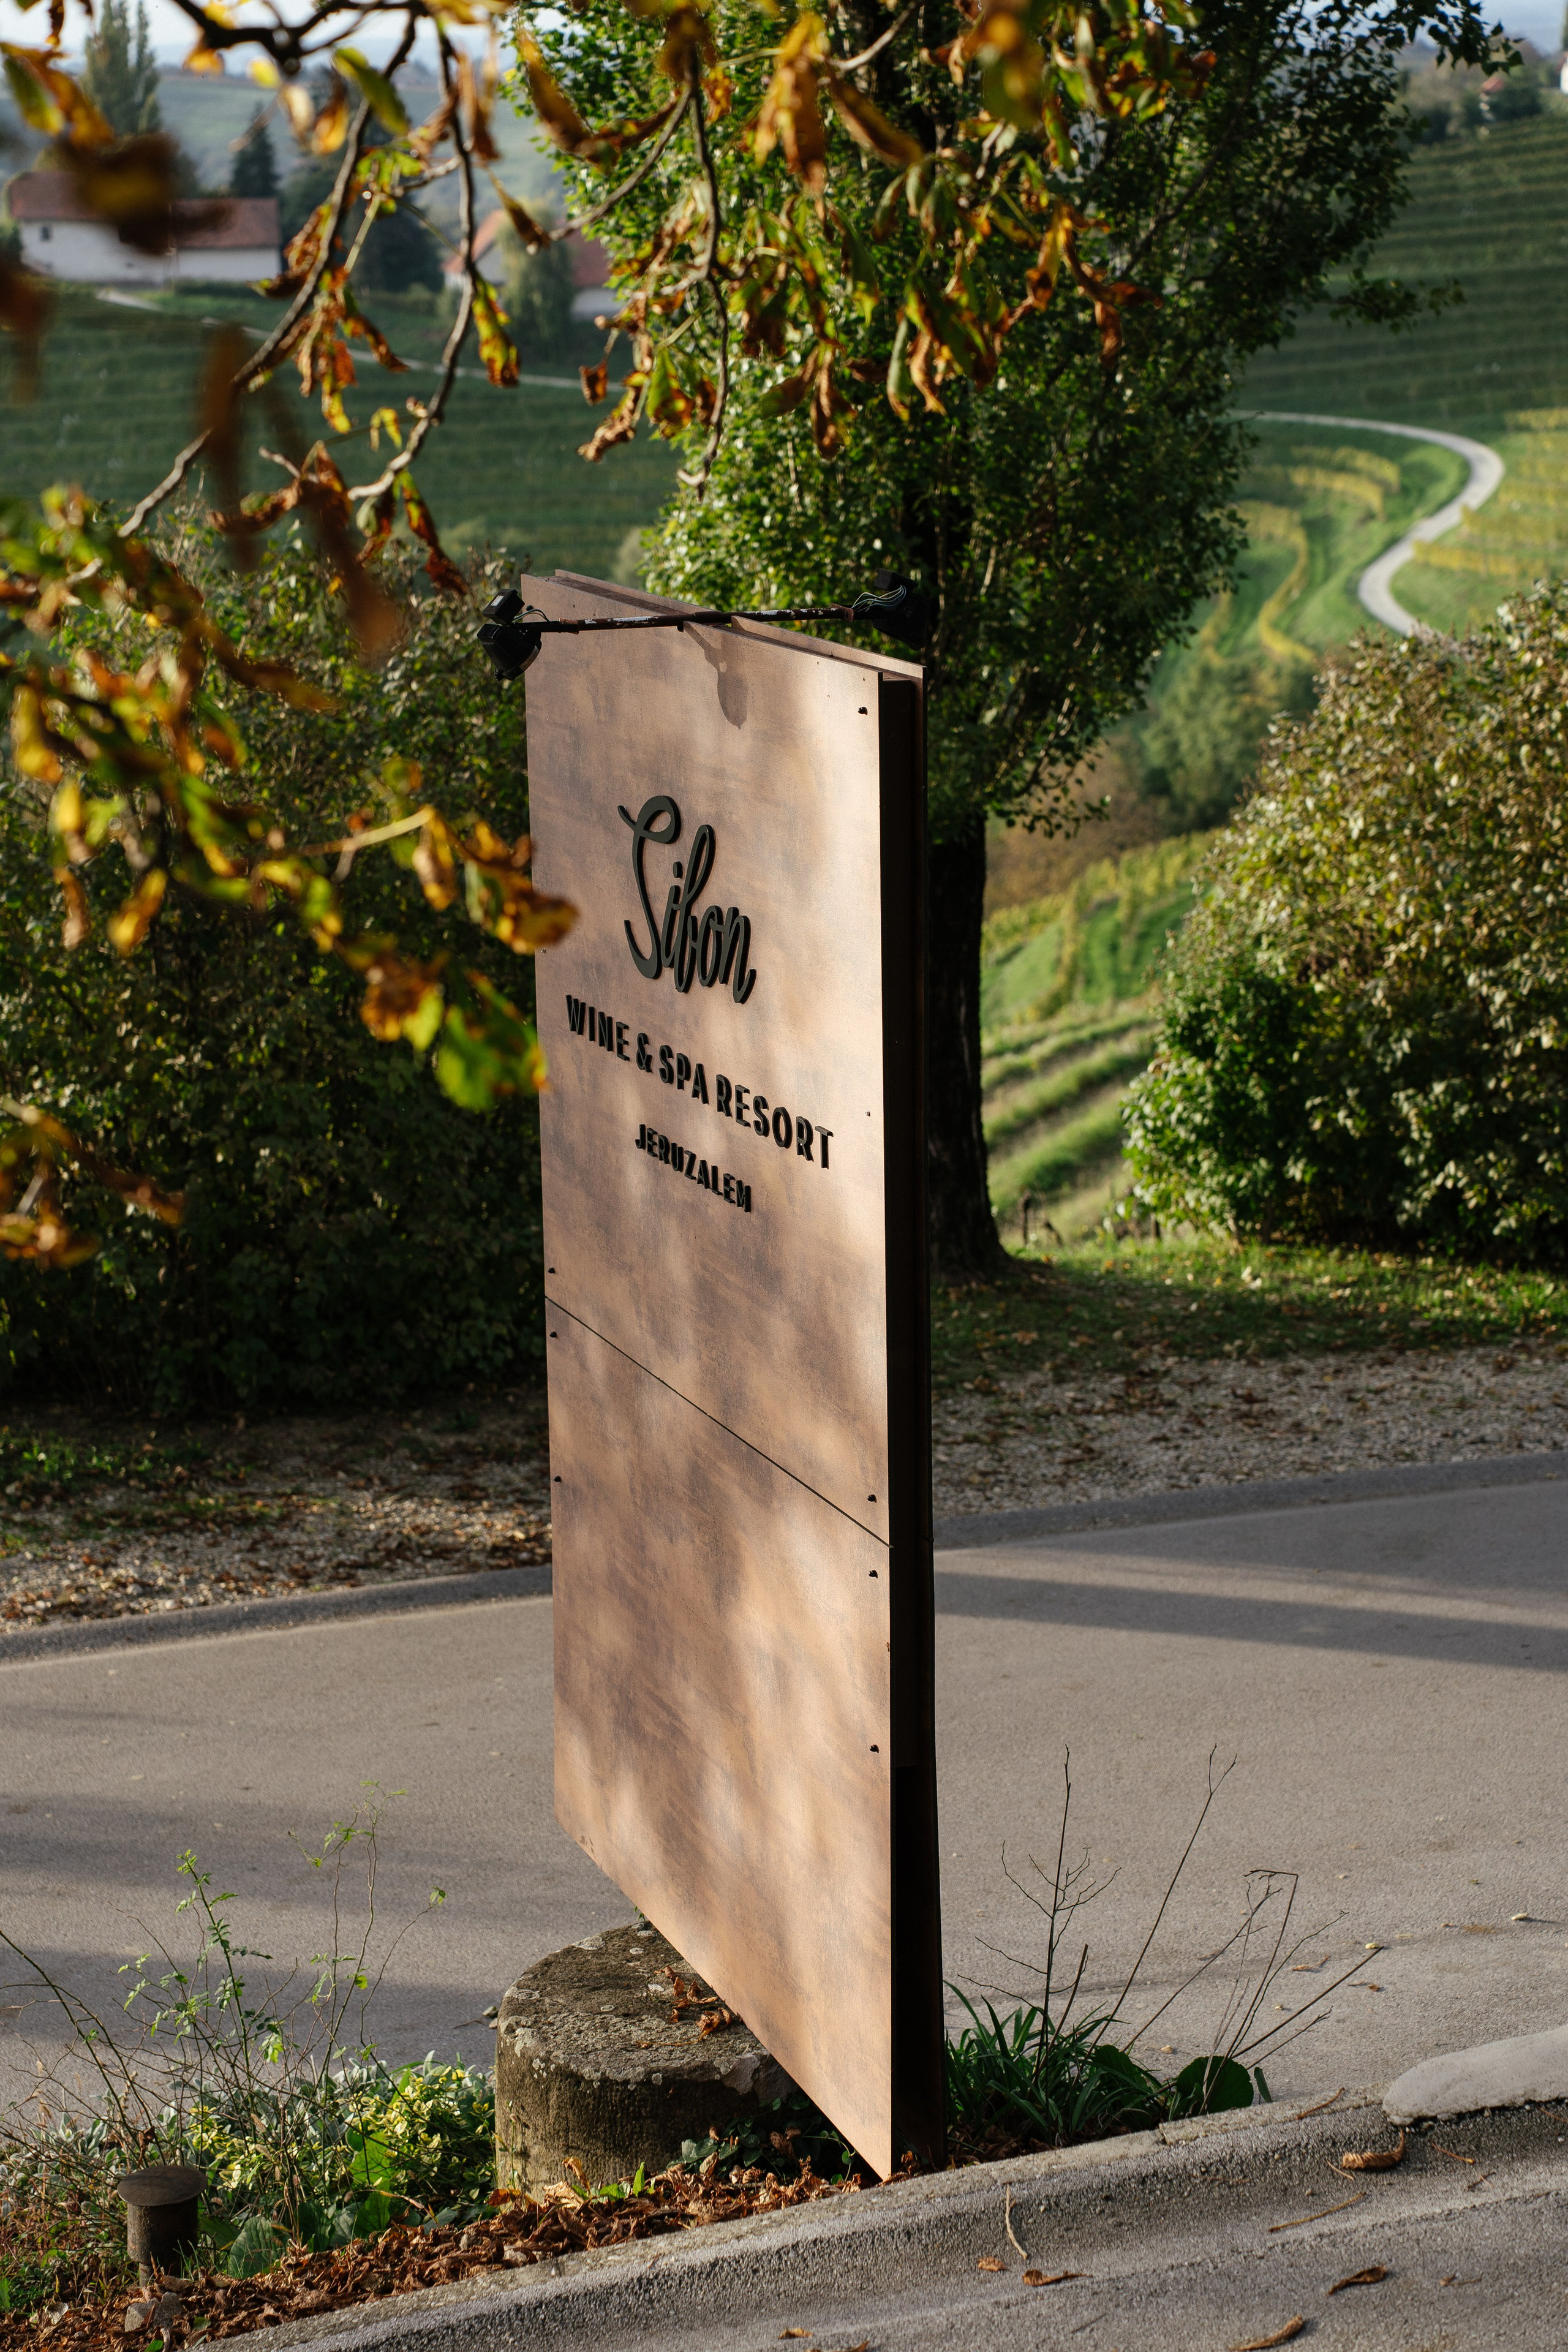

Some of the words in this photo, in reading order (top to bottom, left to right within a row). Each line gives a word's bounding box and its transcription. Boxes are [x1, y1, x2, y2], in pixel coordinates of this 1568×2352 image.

[617, 795, 756, 1005] Sibon
[565, 995, 630, 1061] WINE
[636, 1033, 652, 1072] &
[658, 1045, 710, 1104] SPA
[716, 1074, 834, 1169] RESORT
[635, 1124, 752, 1213] JERUZALEM
